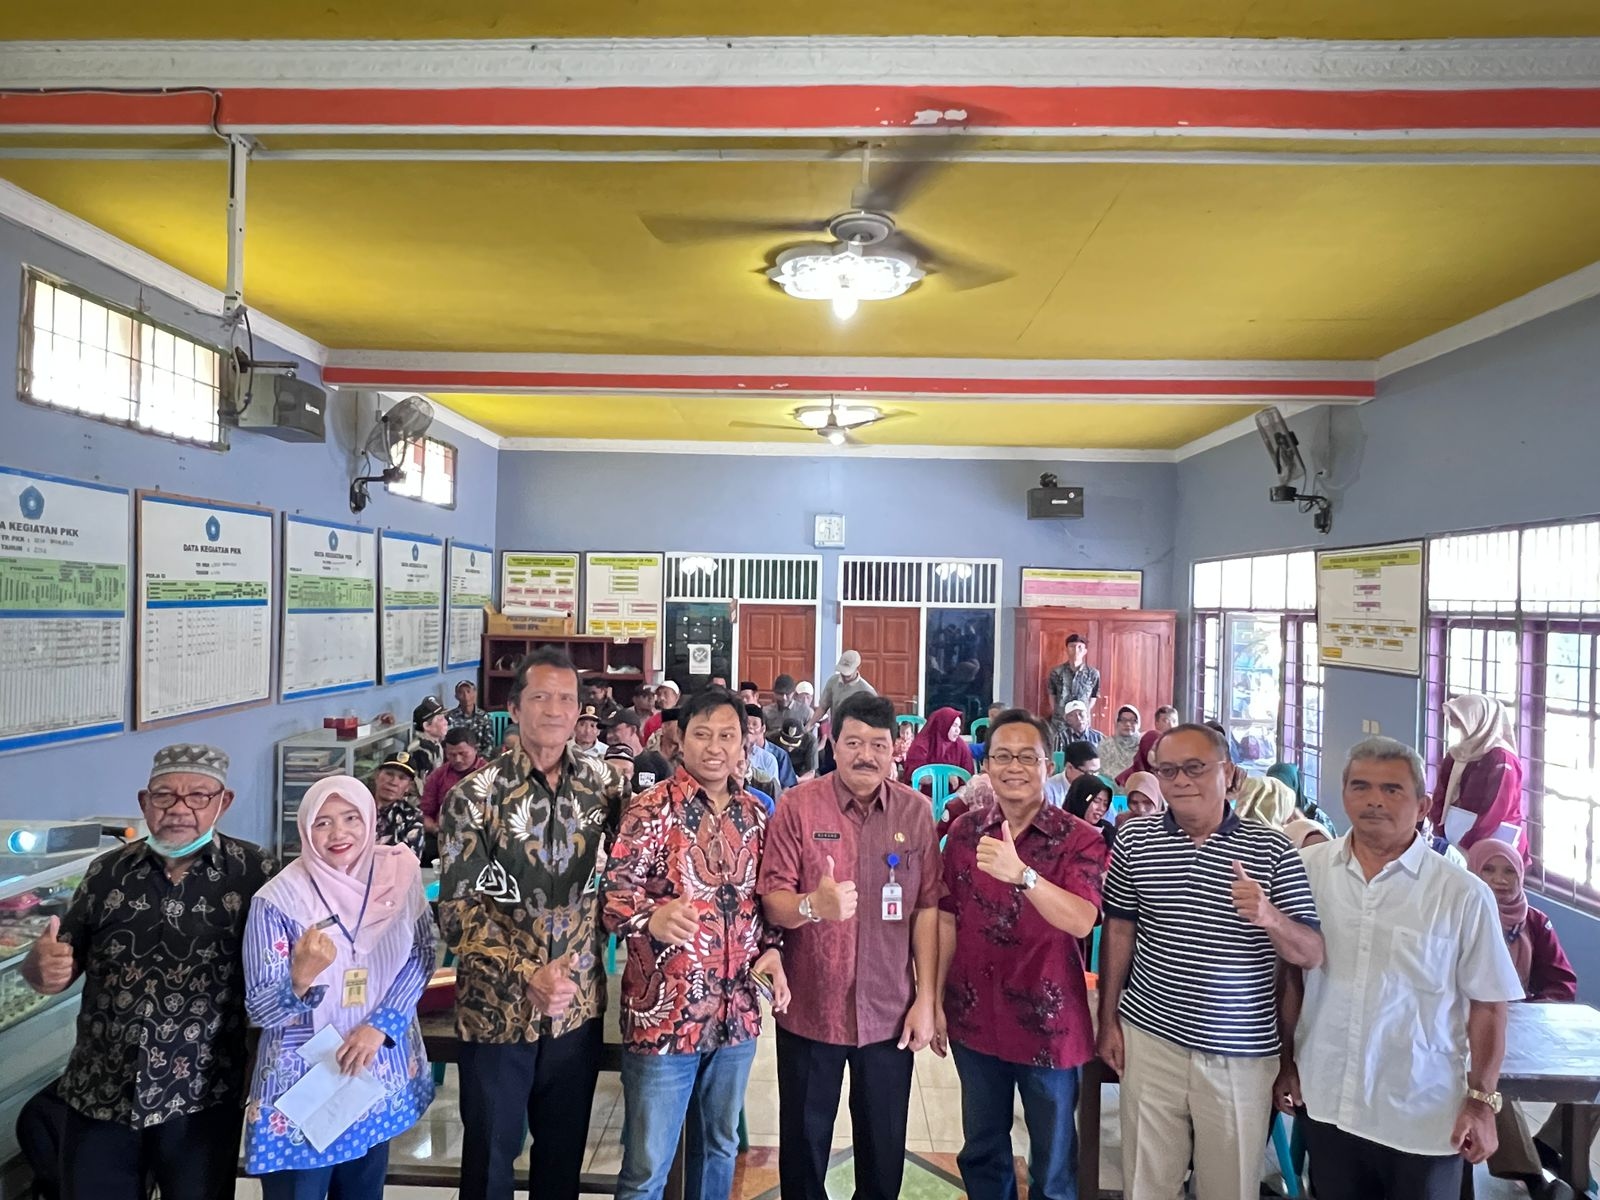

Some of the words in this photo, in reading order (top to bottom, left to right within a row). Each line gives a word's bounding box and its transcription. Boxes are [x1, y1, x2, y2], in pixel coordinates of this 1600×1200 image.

[9, 522, 58, 535] KEGIATAN
[60, 528, 79, 537] PKK
[200, 545, 229, 554] KEGIATAN
